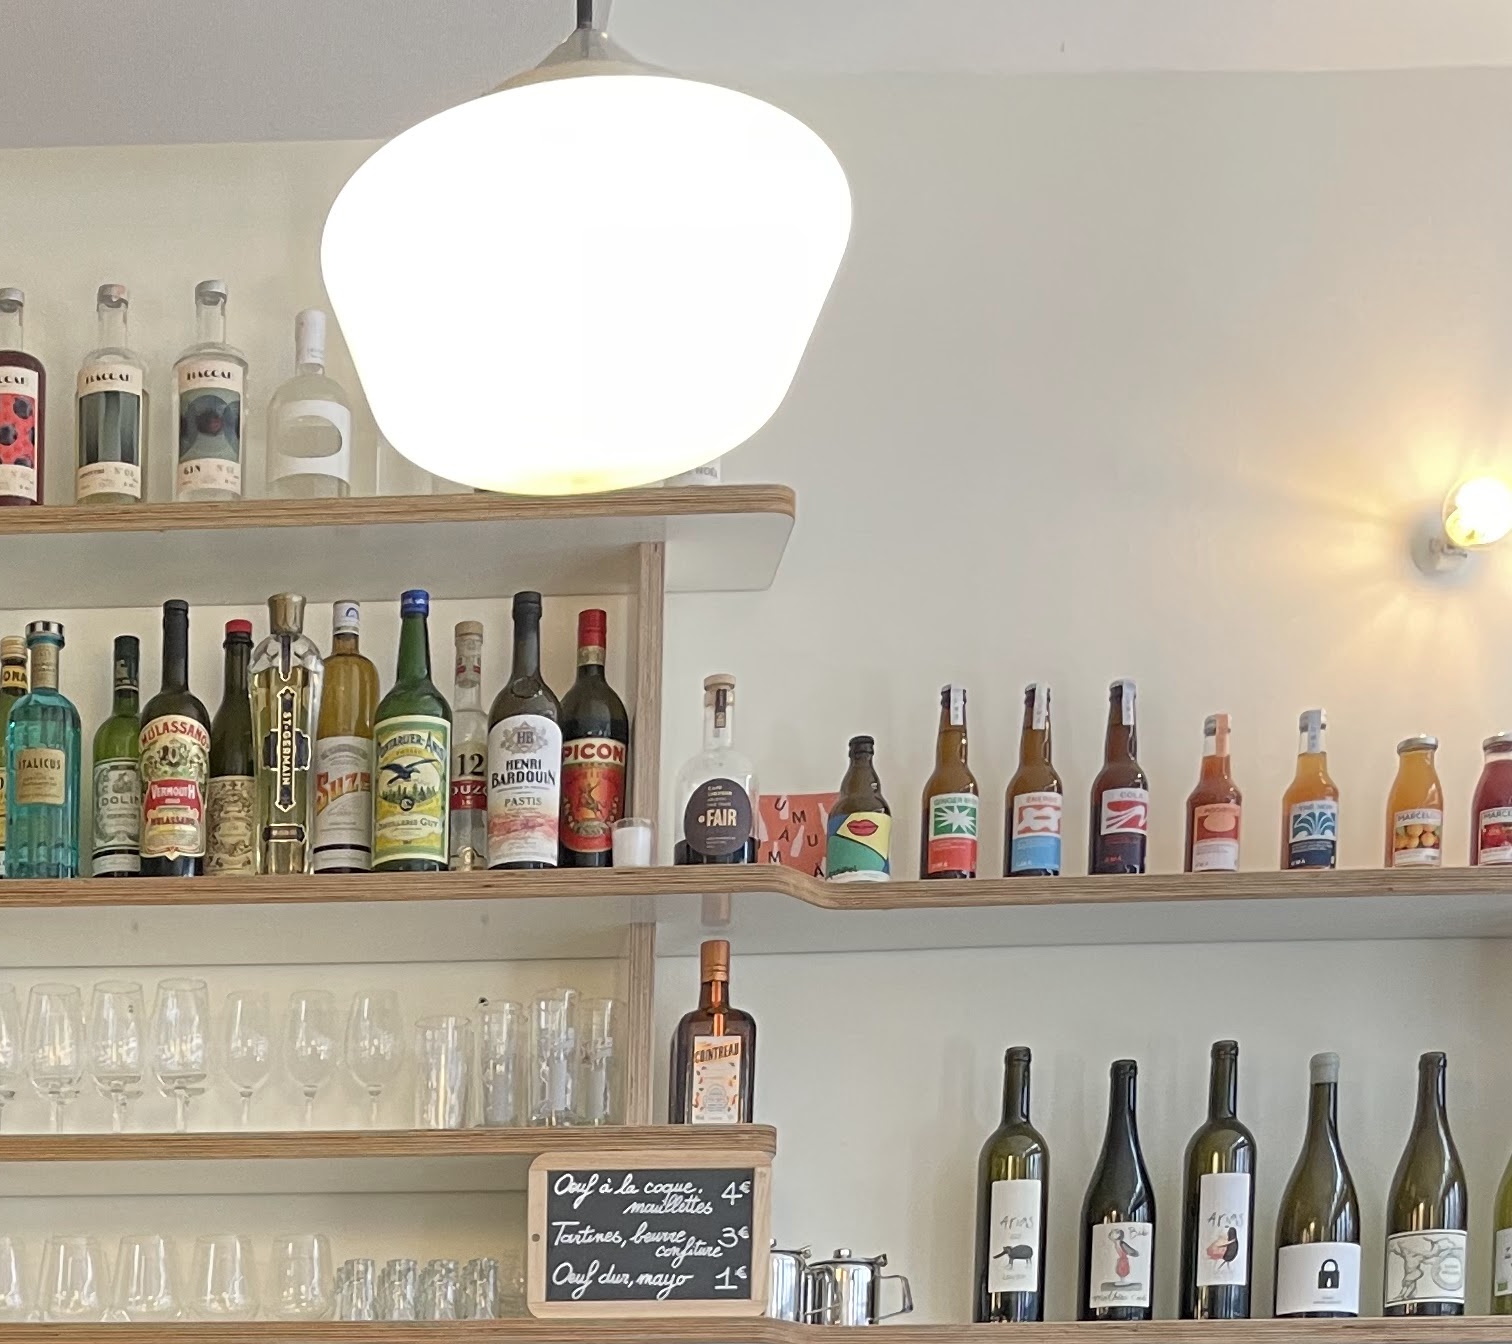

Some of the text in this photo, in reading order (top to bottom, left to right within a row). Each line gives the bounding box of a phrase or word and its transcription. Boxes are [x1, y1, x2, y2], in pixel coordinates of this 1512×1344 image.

[562, 743, 625, 762] PICON
[18, 759, 61, 771] ITALICUS
[457, 753, 484, 777] 12
[505, 758, 542, 771] HENRI
[491, 769, 557, 789] BARDOUIN
[150, 784, 196, 800] VERMOUTH
[316, 770, 371, 817] SUZE
[504, 796, 542, 807] PASTIS
[706, 808, 737, 827] FAIR
[695, 1042, 739, 1063] COINTREAU
[554, 1173, 600, 1209] Oeuf
[599, 1178, 613, 1194] à
[614, 1173, 640, 1195] la
[629, 1221, 687, 1245] beurre
[654, 1238, 724, 1269] confiture
[551, 1260, 600, 1300] Oeuf
[635, 1274, 694, 1300] mayo
